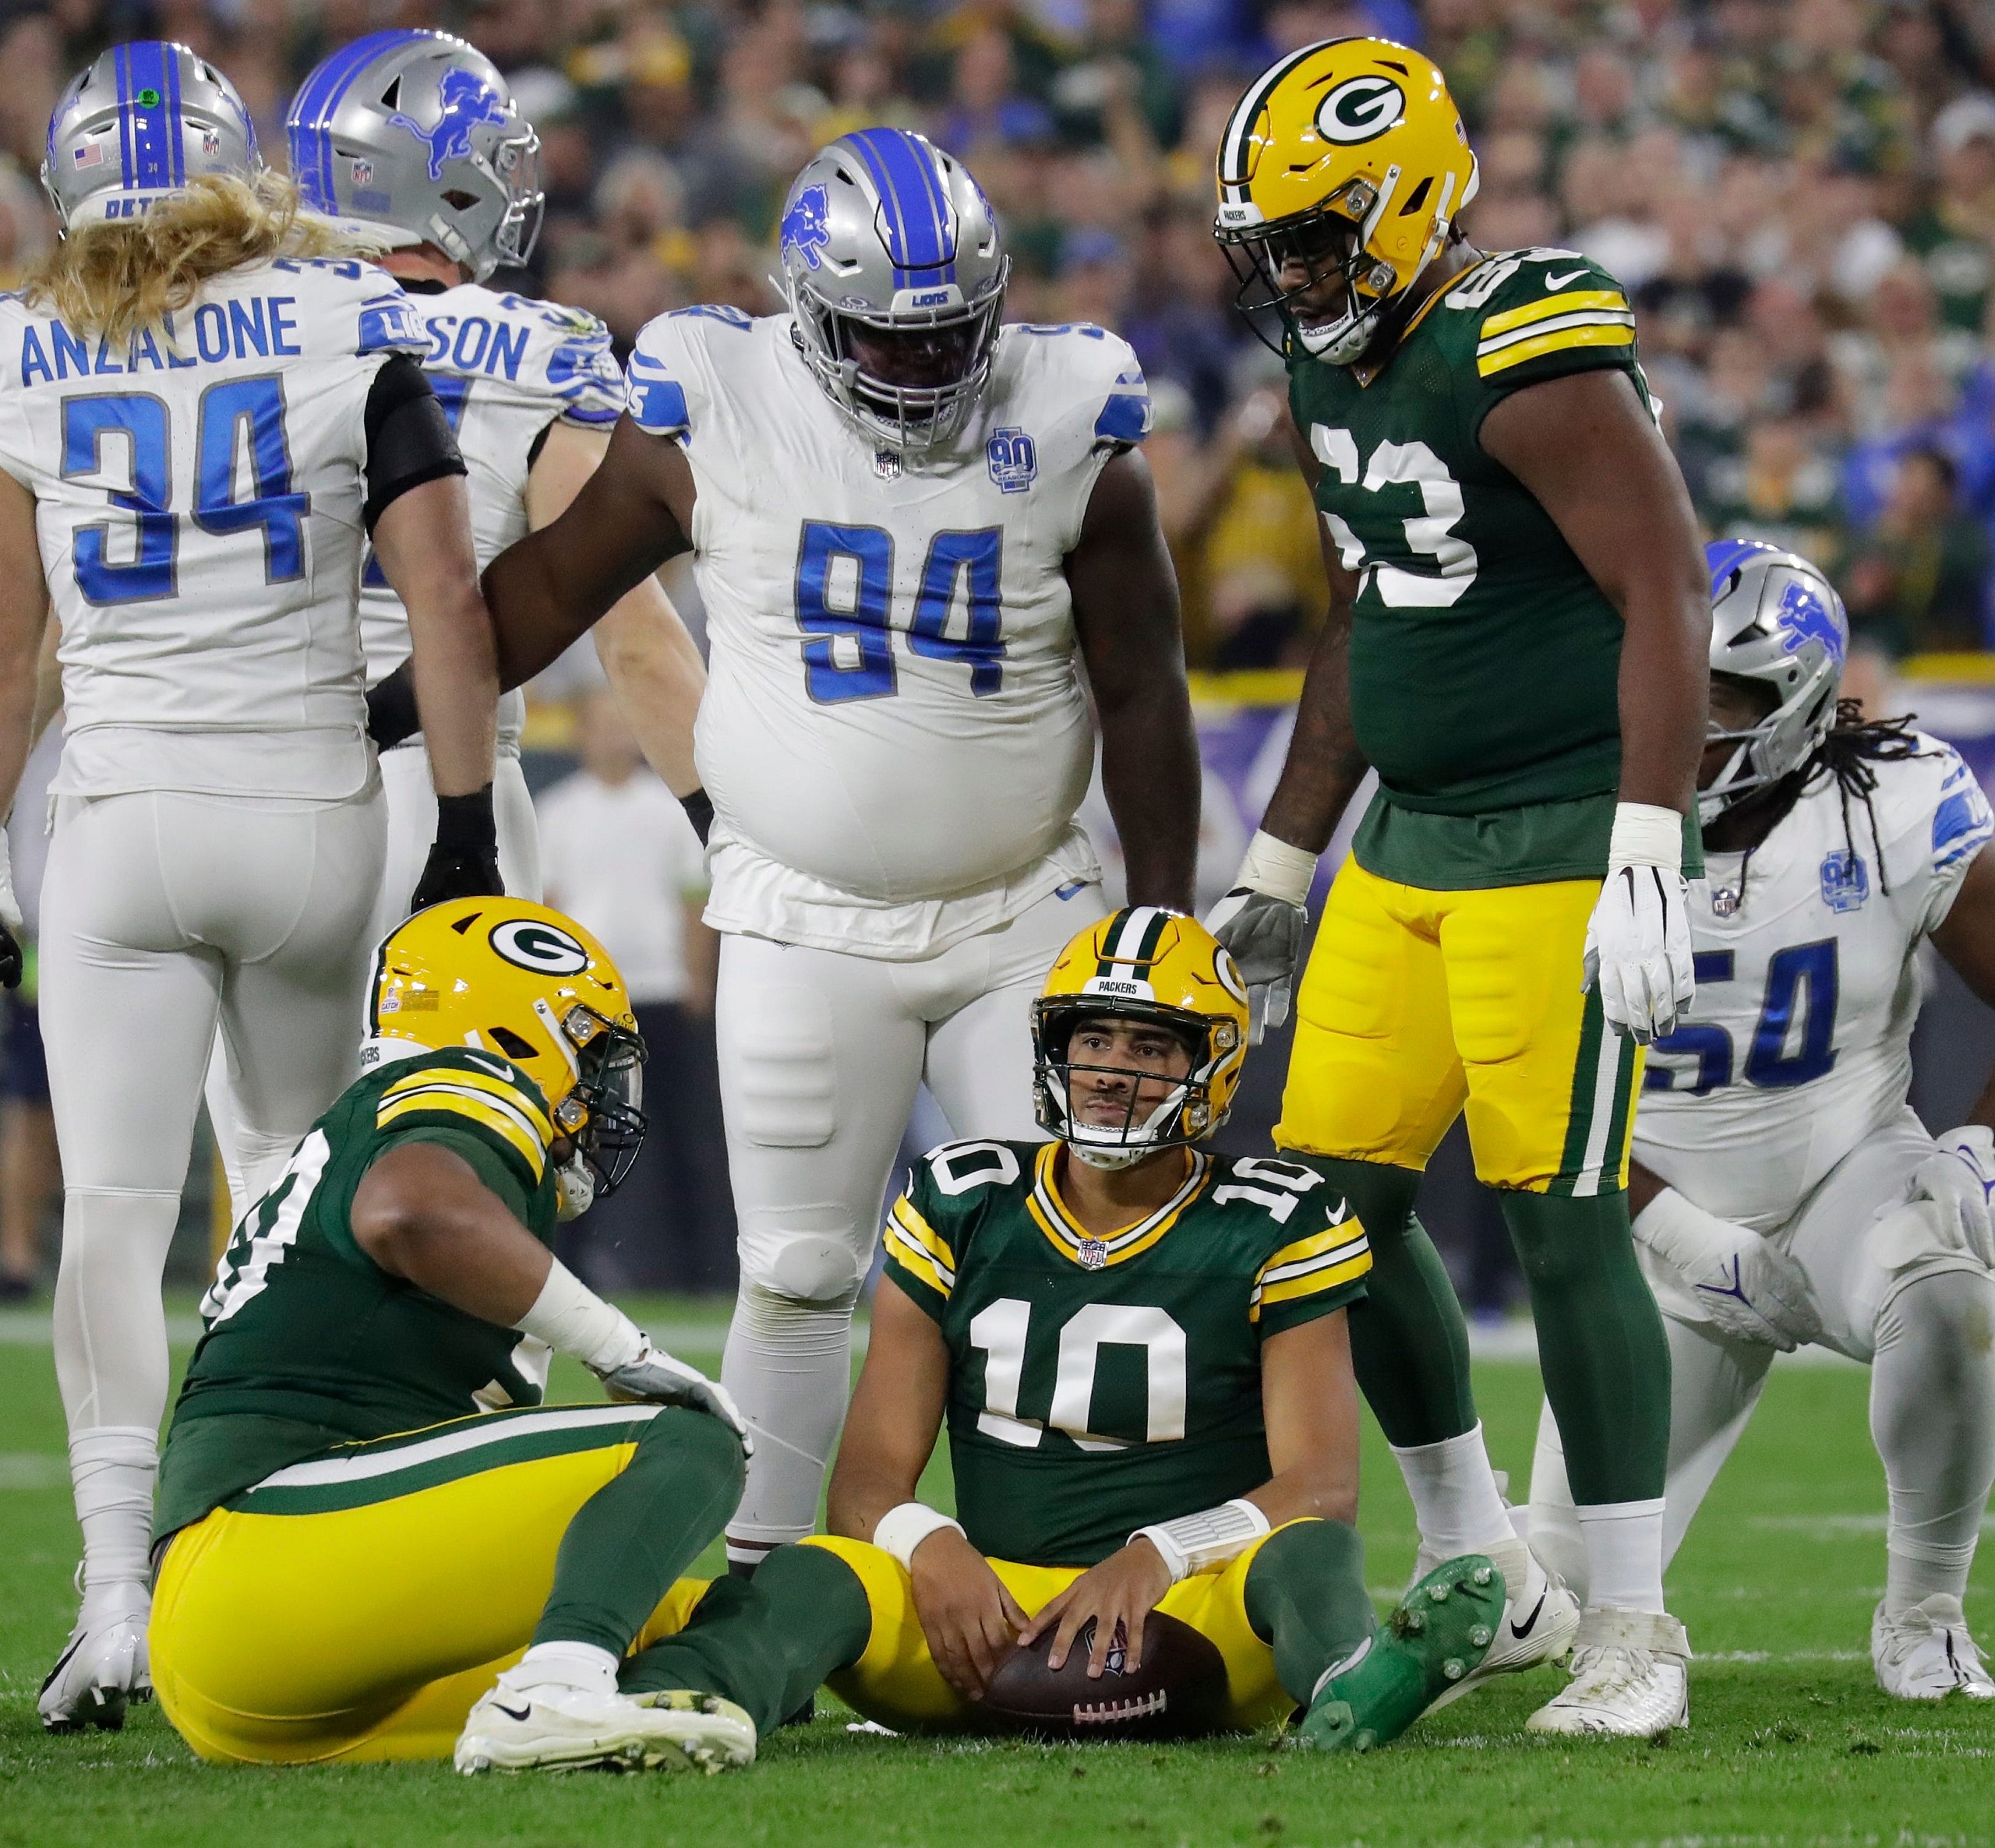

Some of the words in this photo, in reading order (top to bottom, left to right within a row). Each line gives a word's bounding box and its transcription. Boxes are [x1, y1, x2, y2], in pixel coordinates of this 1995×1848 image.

[1317, 77, 1404, 143] G
[147, 162, 158, 174] 34
[912, 291, 948, 307] LIONS
[989, 437, 1034, 474] 90
[59, 372, 312, 608] 34
[794, 518, 1008, 706] 94
[492, 921, 588, 975] G
[1098, 981, 1138, 995] PACKERS
[1643, 936, 1841, 1097] 54
[1212, 1156, 1326, 1225] 10
[969, 1297, 1187, 1452] 10
